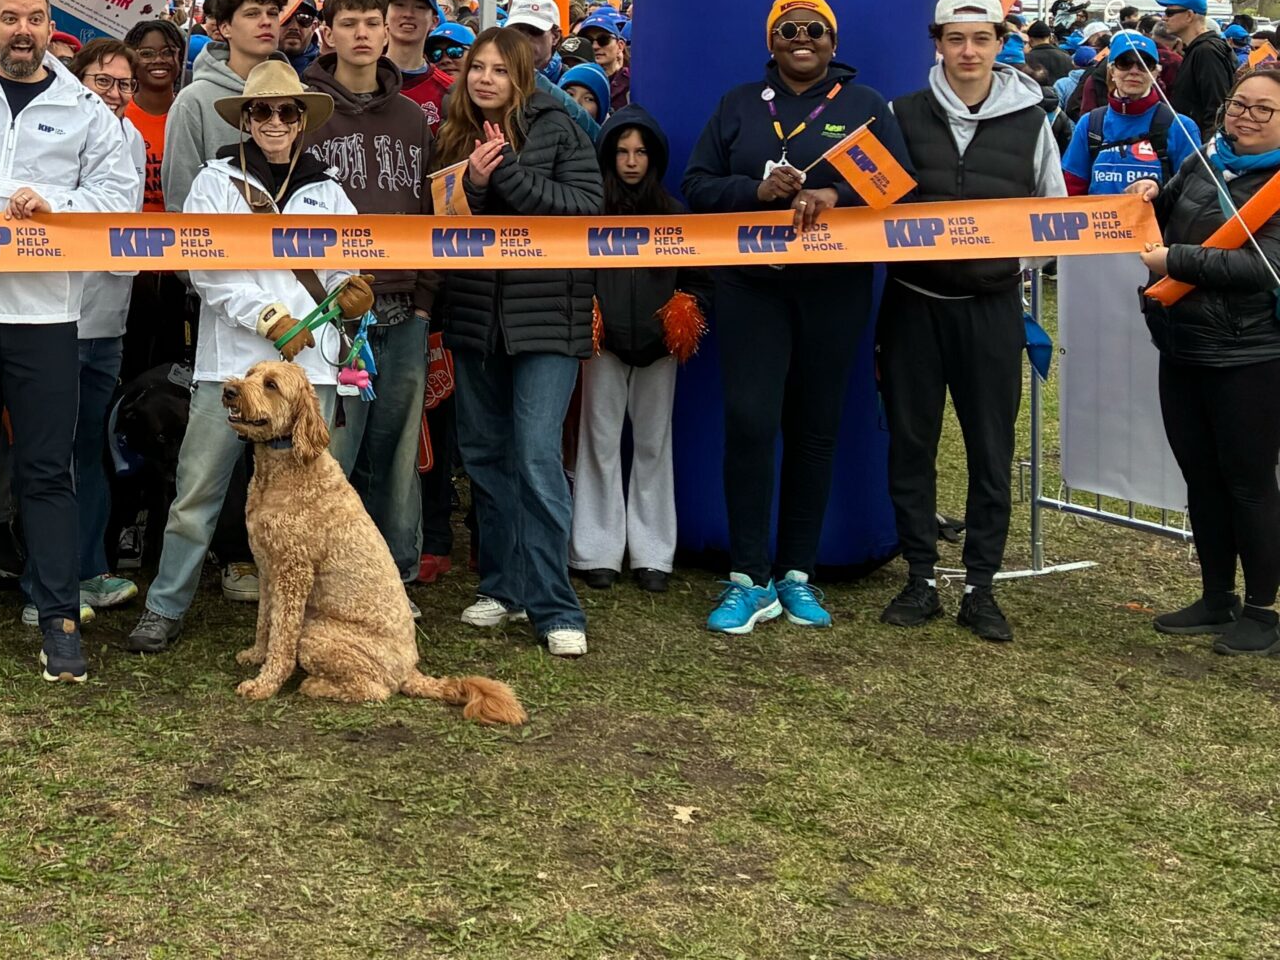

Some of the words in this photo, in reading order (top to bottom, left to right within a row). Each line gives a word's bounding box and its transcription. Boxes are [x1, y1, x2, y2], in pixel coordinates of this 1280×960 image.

[38, 123, 55, 133] KHP
[847, 144, 878, 174] KHP
[1094, 170, 1122, 182] Team
[1092, 211, 1119, 222] KIDS
[948, 217, 975, 228] KIDS
[1030, 212, 1089, 241] KHP
[1093, 221, 1121, 229] HELP
[16, 228, 45, 236] KIDS
[179, 228, 210, 238] KIDS
[341, 229, 371, 238] KIDS
[500, 229, 529, 238] KIDS
[655, 227, 682, 237] KIDS
[885, 218, 944, 247] KHP
[949, 227, 978, 236] HELP
[17, 238, 49, 246] HELP
[109, 228, 175, 256] KHP
[181, 239, 212, 247] HELP
[272, 228, 337, 257] KHP
[342, 239, 373, 247] HELP
[432, 228, 495, 256] KHP
[588, 227, 650, 255] KHP
[654, 237, 684, 245] HELP
[738, 226, 797, 253] KHP
[800, 233, 831, 243] HELP
